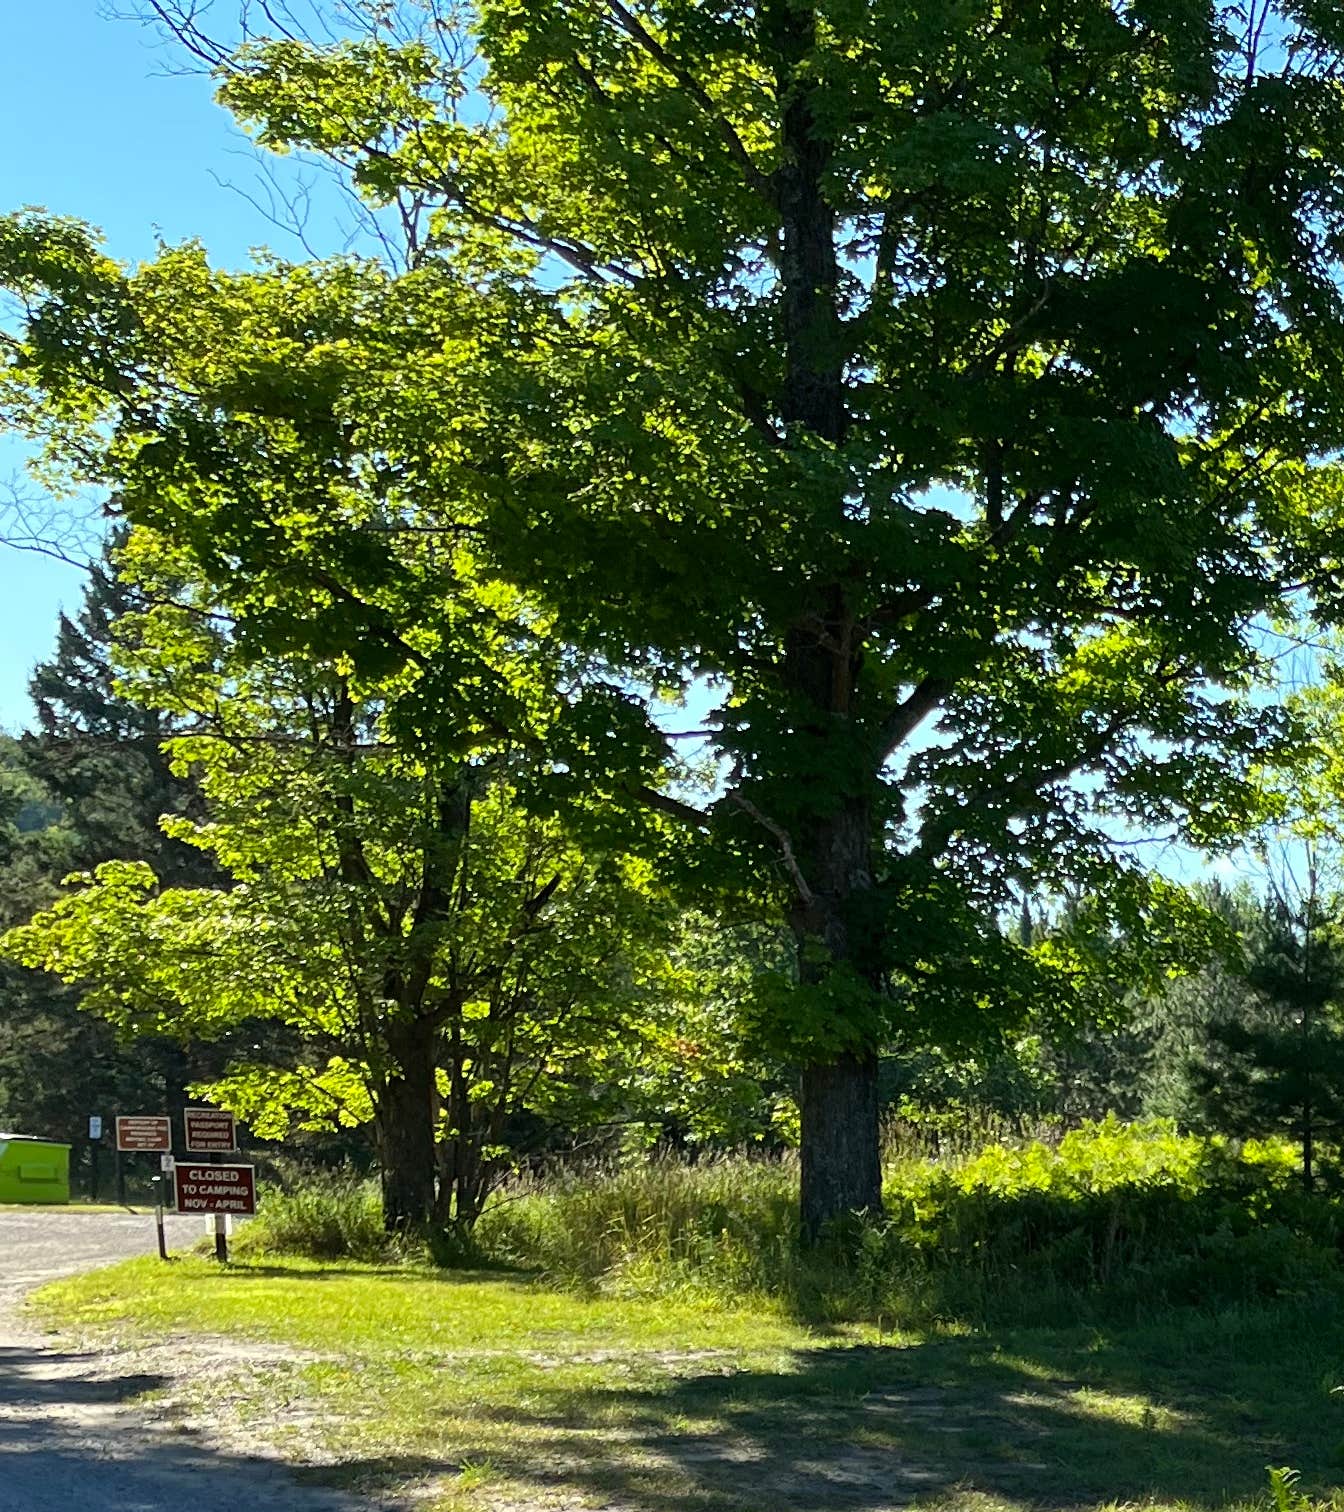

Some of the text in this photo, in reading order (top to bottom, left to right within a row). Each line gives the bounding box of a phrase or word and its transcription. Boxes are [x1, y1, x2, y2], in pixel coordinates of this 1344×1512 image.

[190, 1121, 229, 1129] PASSPORT
[188, 1169, 239, 1182] CLOSED
[182, 1184, 249, 1196] TO CAMPING
[184, 1199, 208, 1209] NOV
[215, 1199, 247, 1210] APRIL
